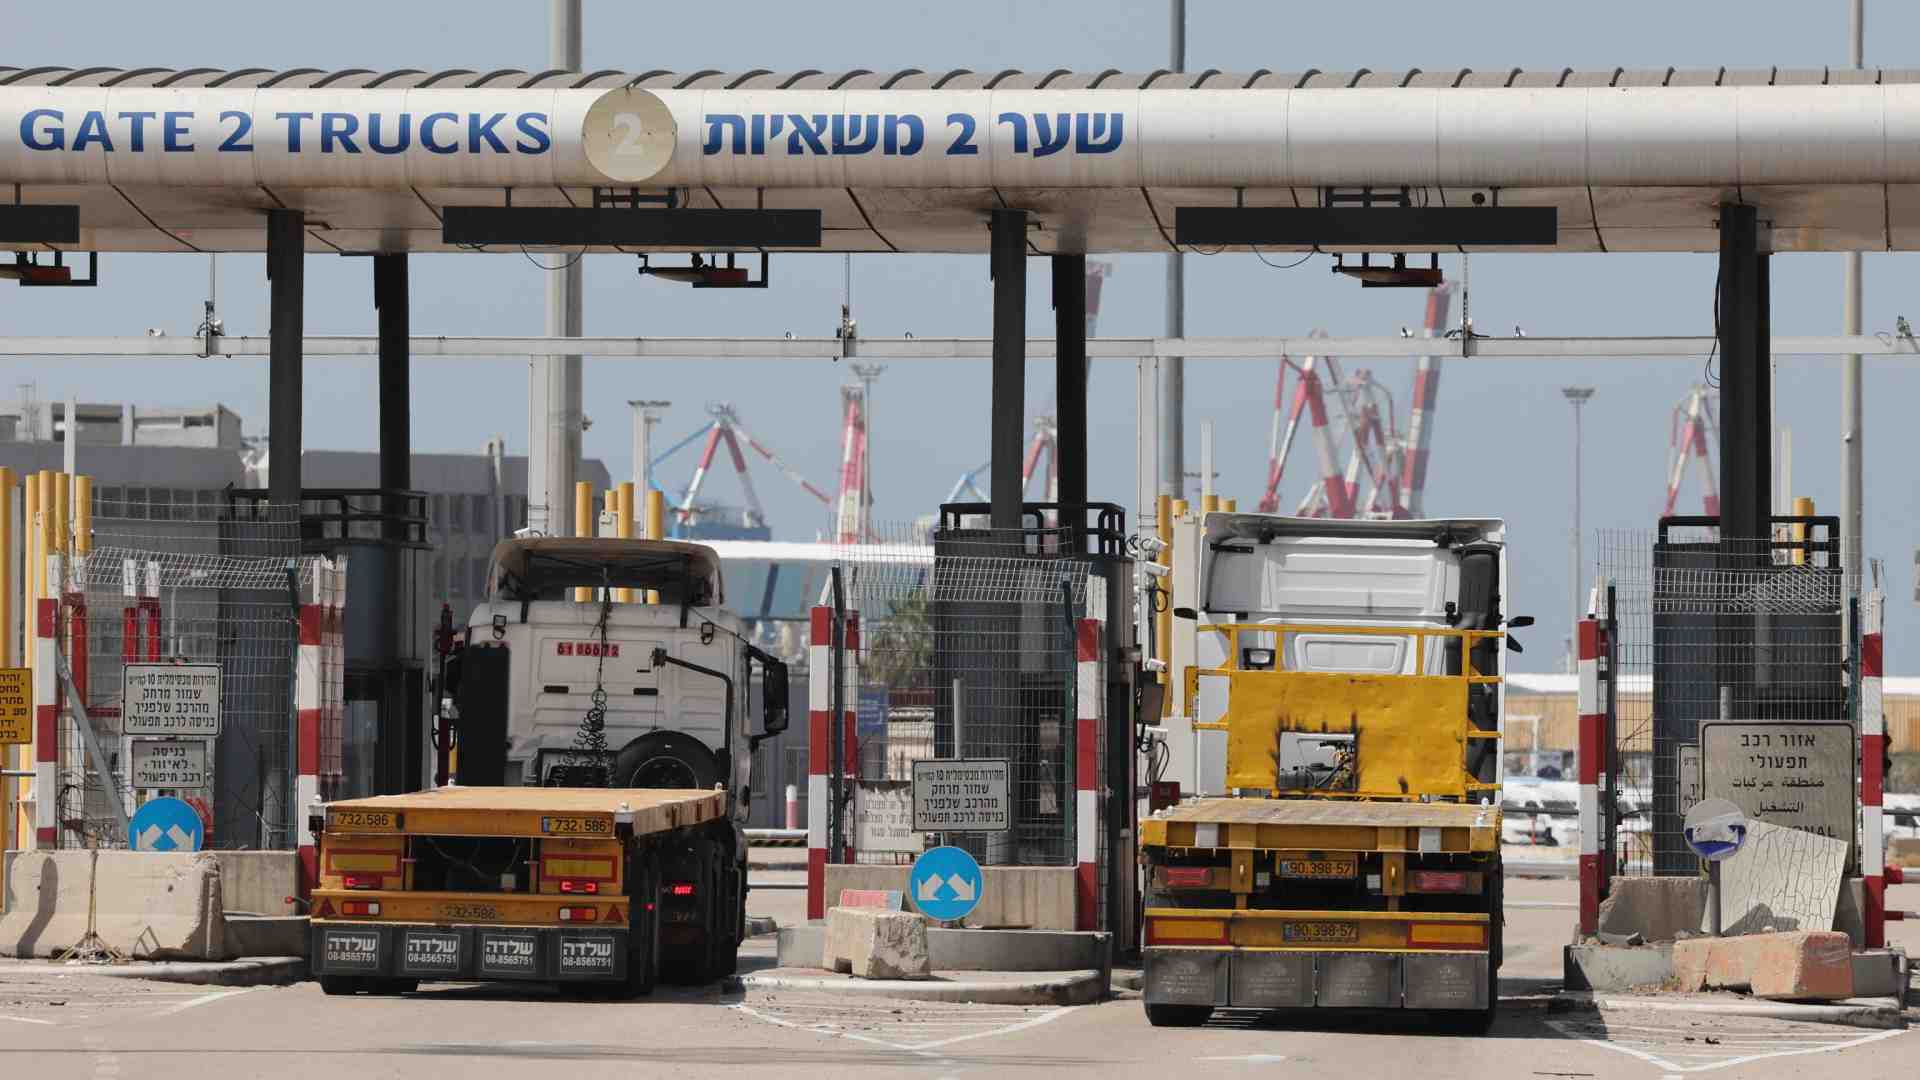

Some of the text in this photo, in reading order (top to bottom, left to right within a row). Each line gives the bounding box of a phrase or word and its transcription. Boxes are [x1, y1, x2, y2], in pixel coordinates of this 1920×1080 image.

[19, 108, 552, 155] GATE 2 TRUCKS
[608, 112, 643, 155] 2
[702, 112, 1124, 158] שער 2 משאיות
[143, 688, 201, 700] שמור מרחק
[135, 701, 209, 714] מהרכב שלפניך
[1740, 733, 1816, 747] אזור רכב
[1750, 754, 1808, 769] תפעולי
[931, 783, 990, 796] שמור מרחק
[923, 797, 961, 810] שלפניך
[964, 798, 998, 809] מהרכב
[327, 936, 377, 951] שלדה
[408, 938, 457, 953] שלדה
[486, 940, 534, 955] שלדה
[563, 942, 611, 956] שלדה
